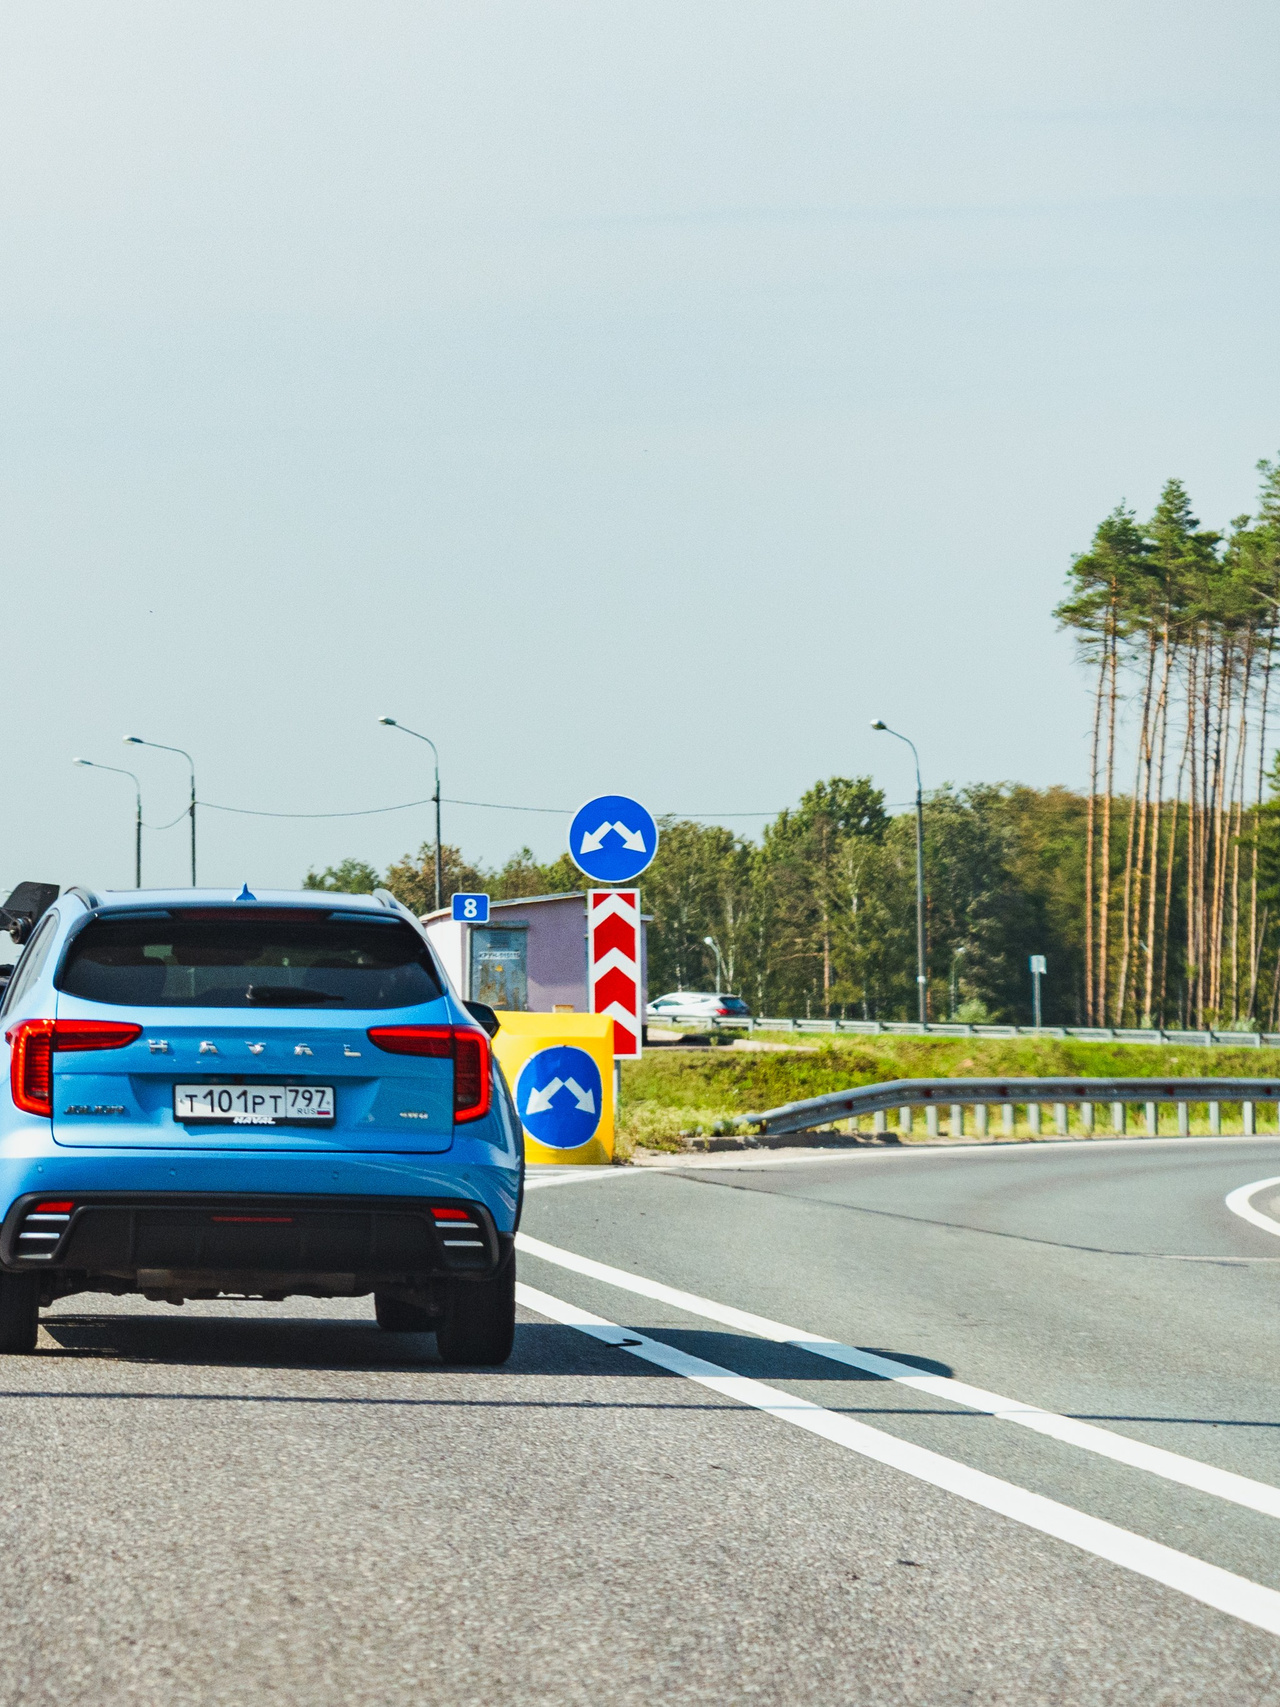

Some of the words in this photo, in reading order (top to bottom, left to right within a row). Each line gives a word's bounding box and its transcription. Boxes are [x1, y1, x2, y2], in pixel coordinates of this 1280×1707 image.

[463, 898, 478, 918] 8
[148, 1039, 362, 1058] HAVAL
[297, 1107, 317, 1115] RUS
[233, 1116, 277, 1125] HAVAL
